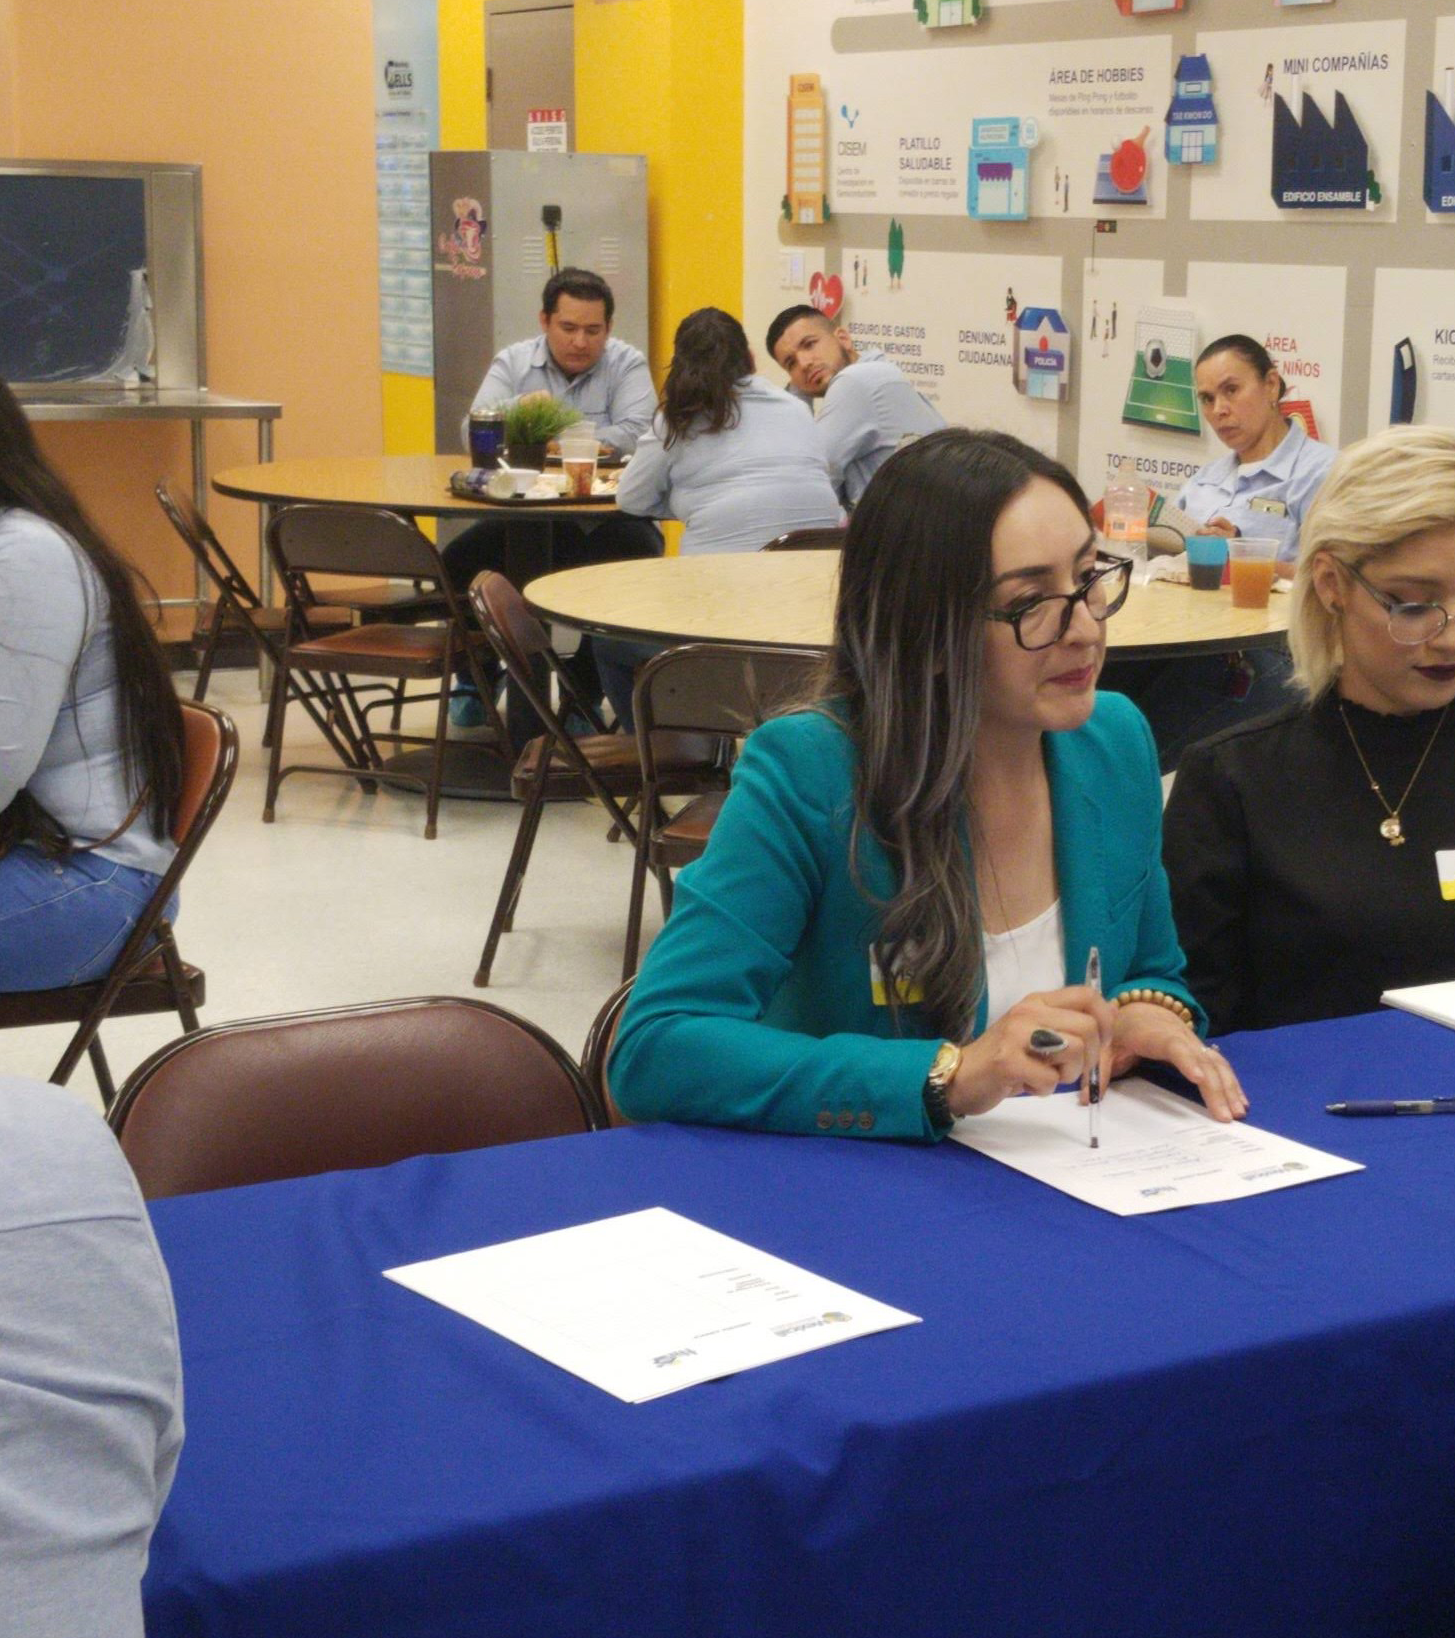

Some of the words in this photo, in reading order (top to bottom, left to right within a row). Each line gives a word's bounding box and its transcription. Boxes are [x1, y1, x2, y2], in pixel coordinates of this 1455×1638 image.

[1283, 57, 1309, 74] MINI
[1312, 51, 1389, 73] COMPAÑÍAS
[1049, 67, 1078, 84] ÁREA
[1080, 69, 1095, 83] DE
[1097, 67, 1144, 83] HOBBIES
[899, 137, 941, 150] PLATILLO
[899, 157, 952, 170] SALUDABLE
[1283, 192, 1316, 202] EDIFICIO
[1317, 191, 1361, 202] ENSAMBLE
[849, 322, 879, 336] SEGURO
[881, 324, 893, 337] DE
[893, 325, 926, 340] GASTOS
[958, 330, 1007, 345] DENUNCIA
[1264, 333, 1297, 352] ÁREA
[958, 350, 1013, 367] CIUDADANA
[1282, 358, 1320, 377] NIÑOS
